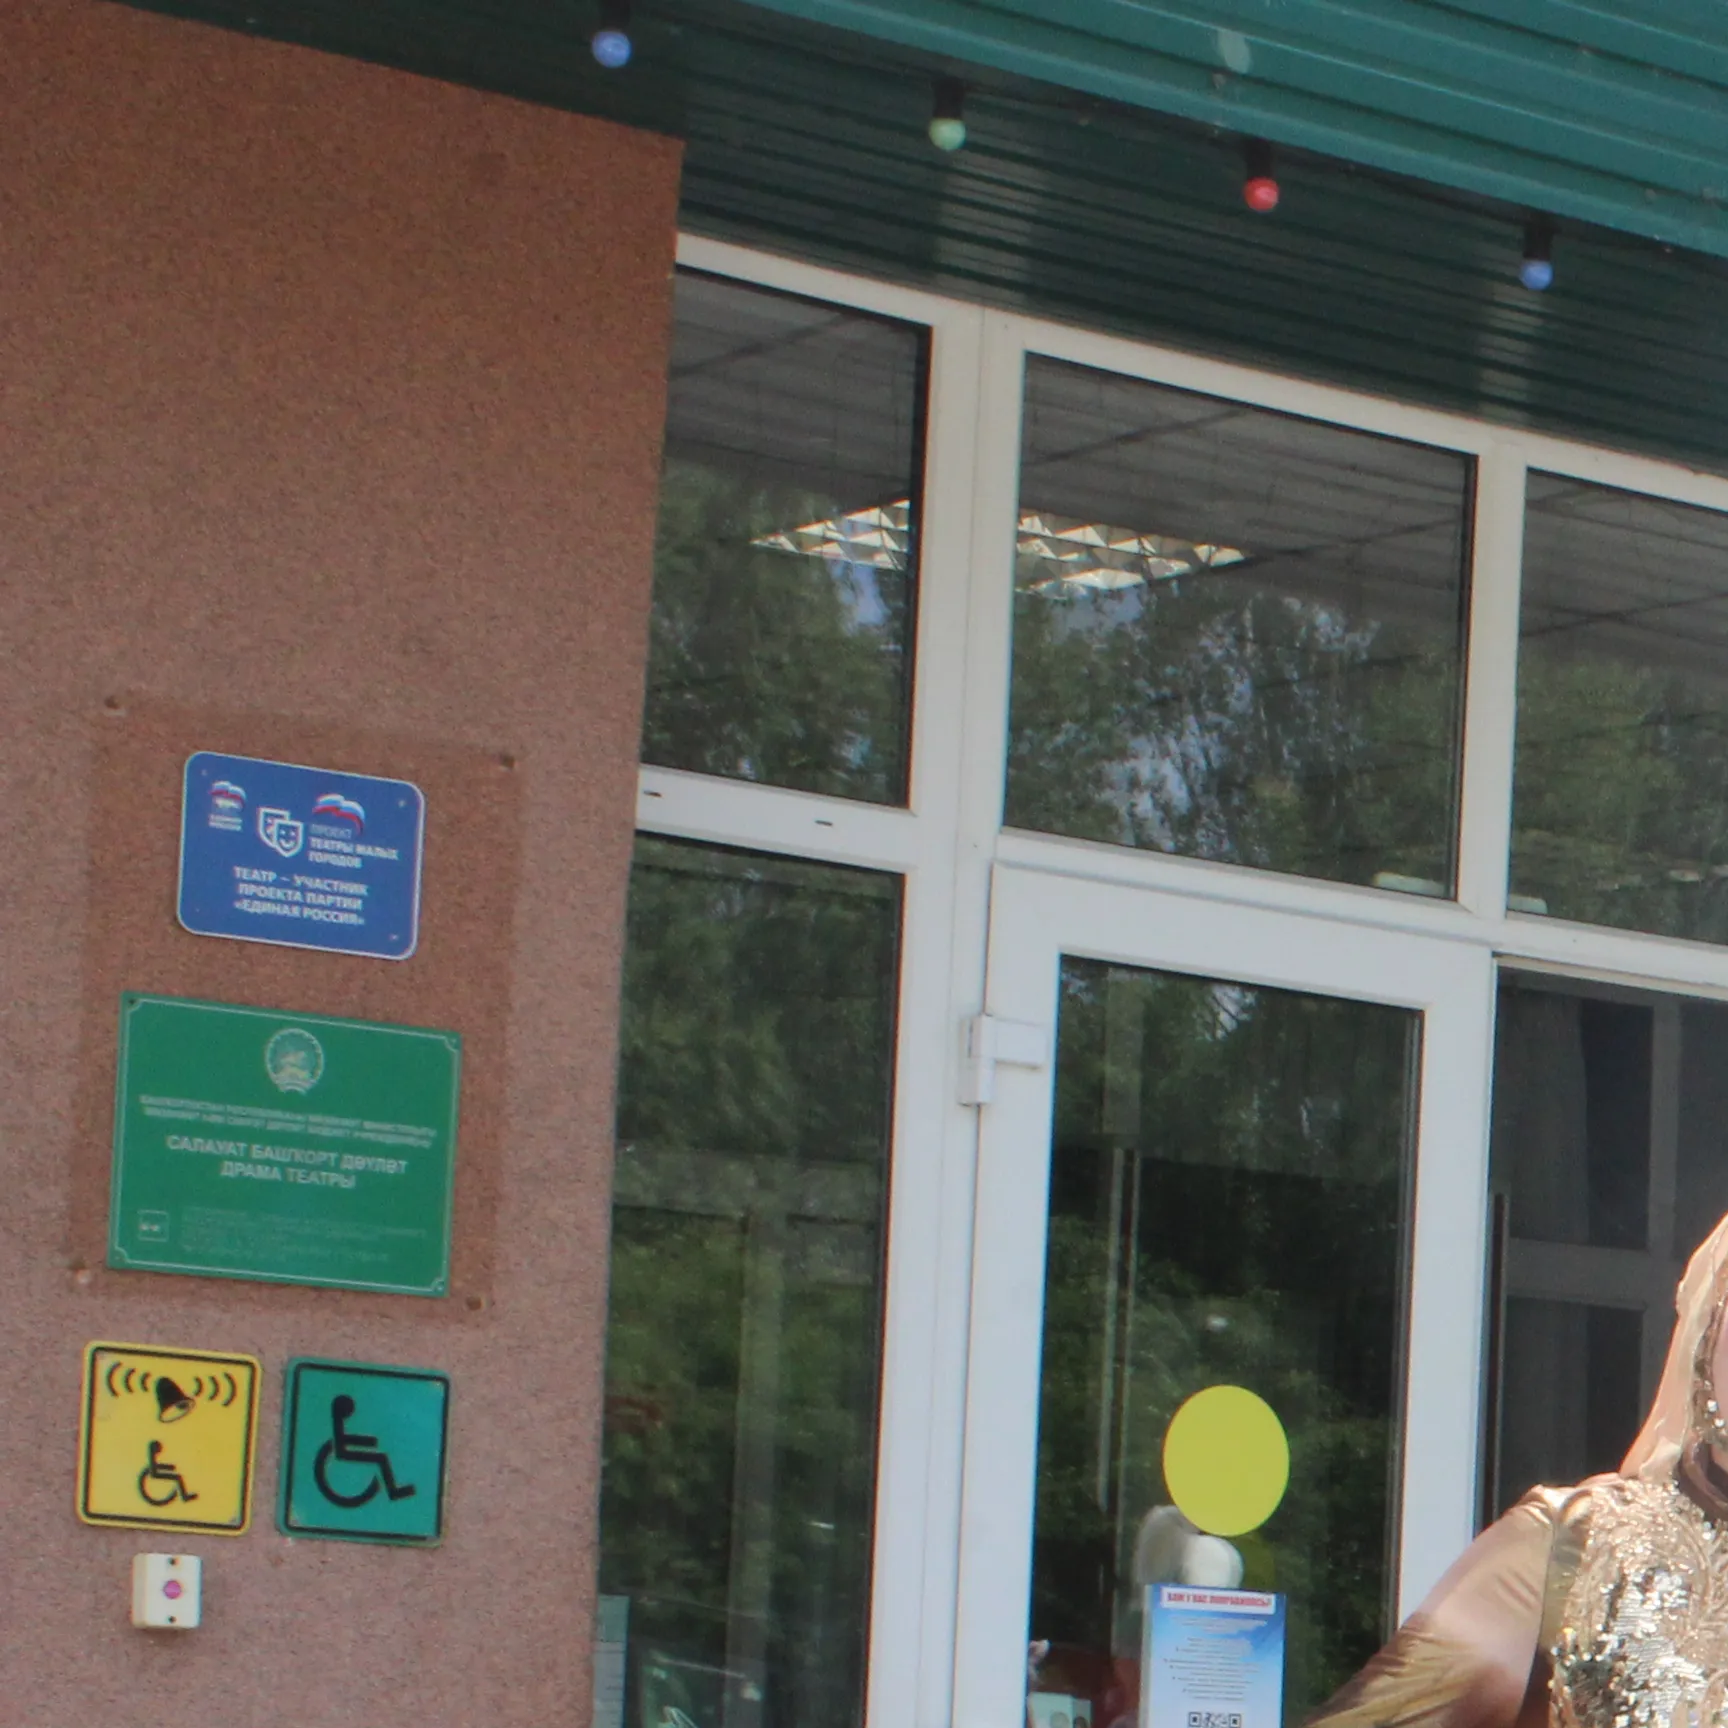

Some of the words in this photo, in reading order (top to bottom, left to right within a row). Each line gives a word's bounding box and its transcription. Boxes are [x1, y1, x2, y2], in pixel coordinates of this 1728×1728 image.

[309, 836, 354, 854] ТЕАТРЫ
[233, 866, 277, 883] ТЕАТР
[293, 873, 368, 896] УЧАСТНИК
[238, 883, 303, 903] ПРОЕКТА
[306, 891, 363, 911] ПАРТИИ
[166, 1134, 248, 1158] САЛАУАТ
[219, 1160, 282, 1182] ДРАМА
[286, 1166, 356, 1189] ТЕАТРЫ
